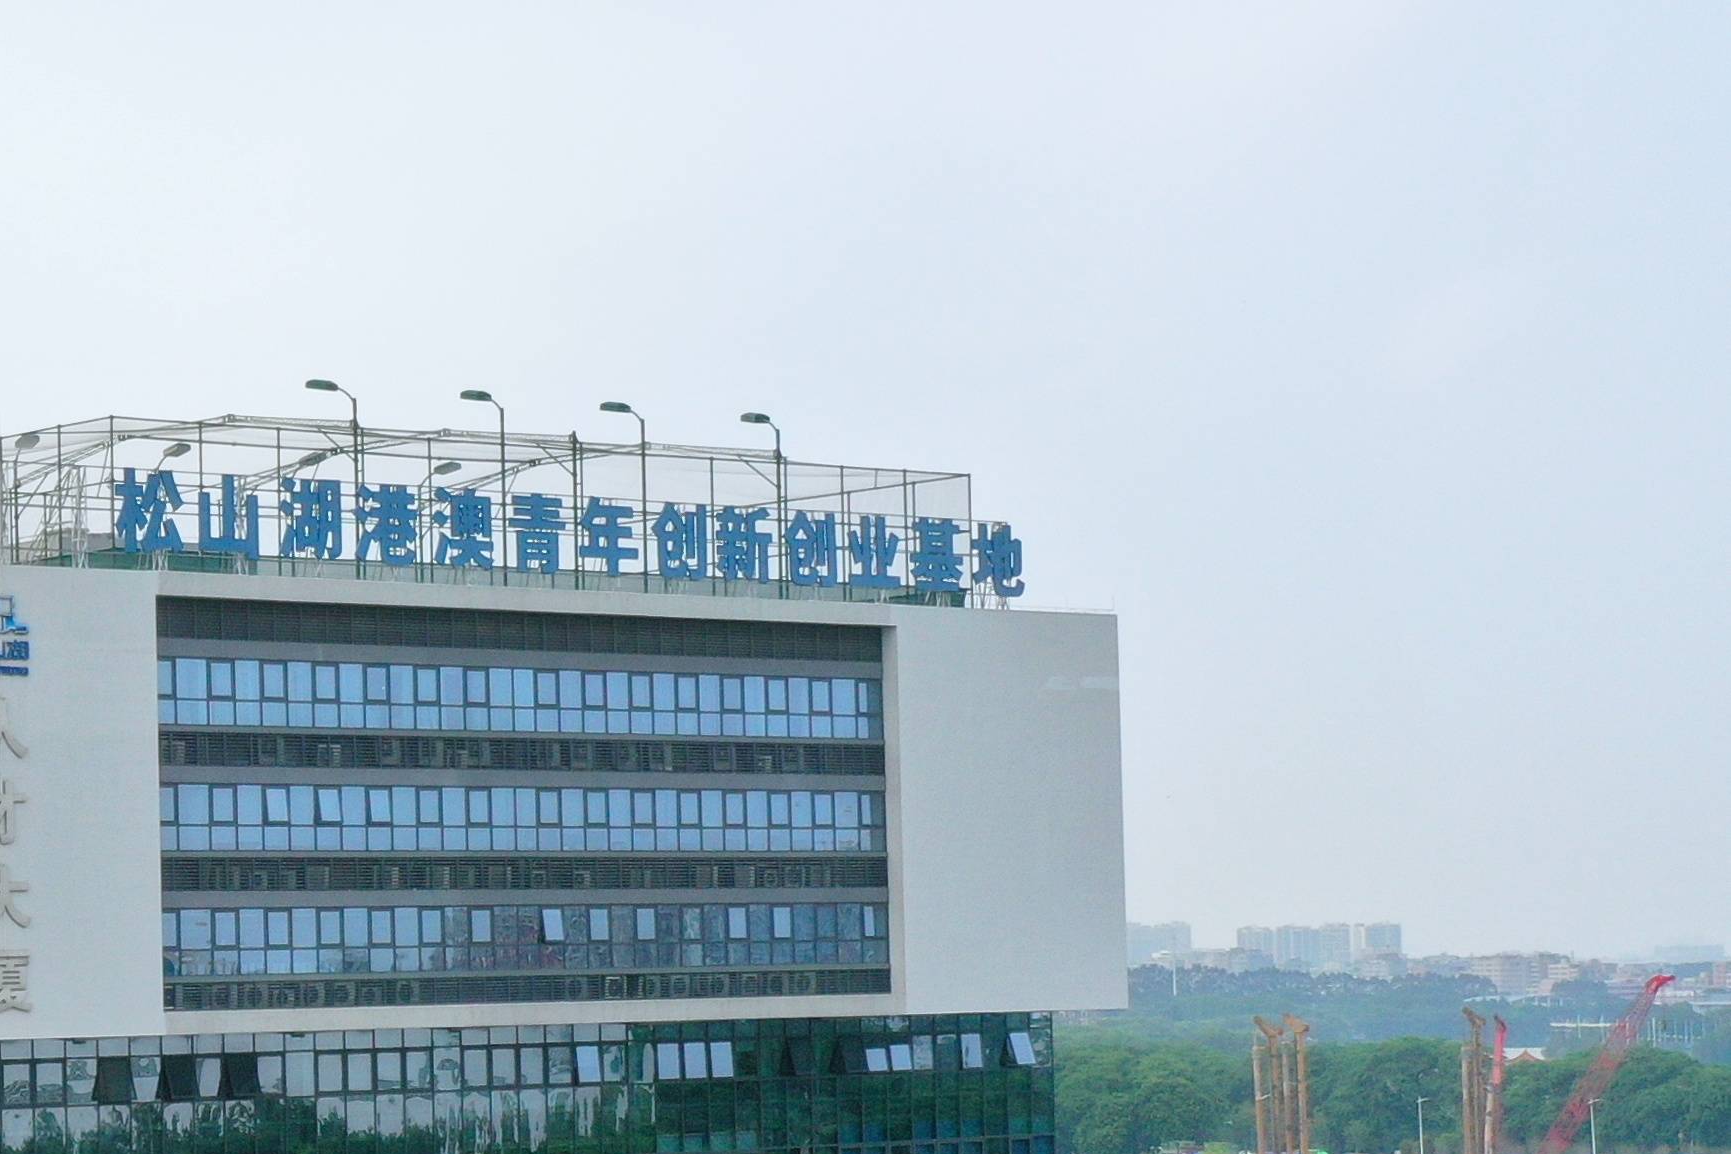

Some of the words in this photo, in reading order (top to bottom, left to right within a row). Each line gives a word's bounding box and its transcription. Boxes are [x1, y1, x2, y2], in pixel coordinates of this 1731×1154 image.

[115, 467, 1026, 598] 松山湖港澳青年创新创业基地
